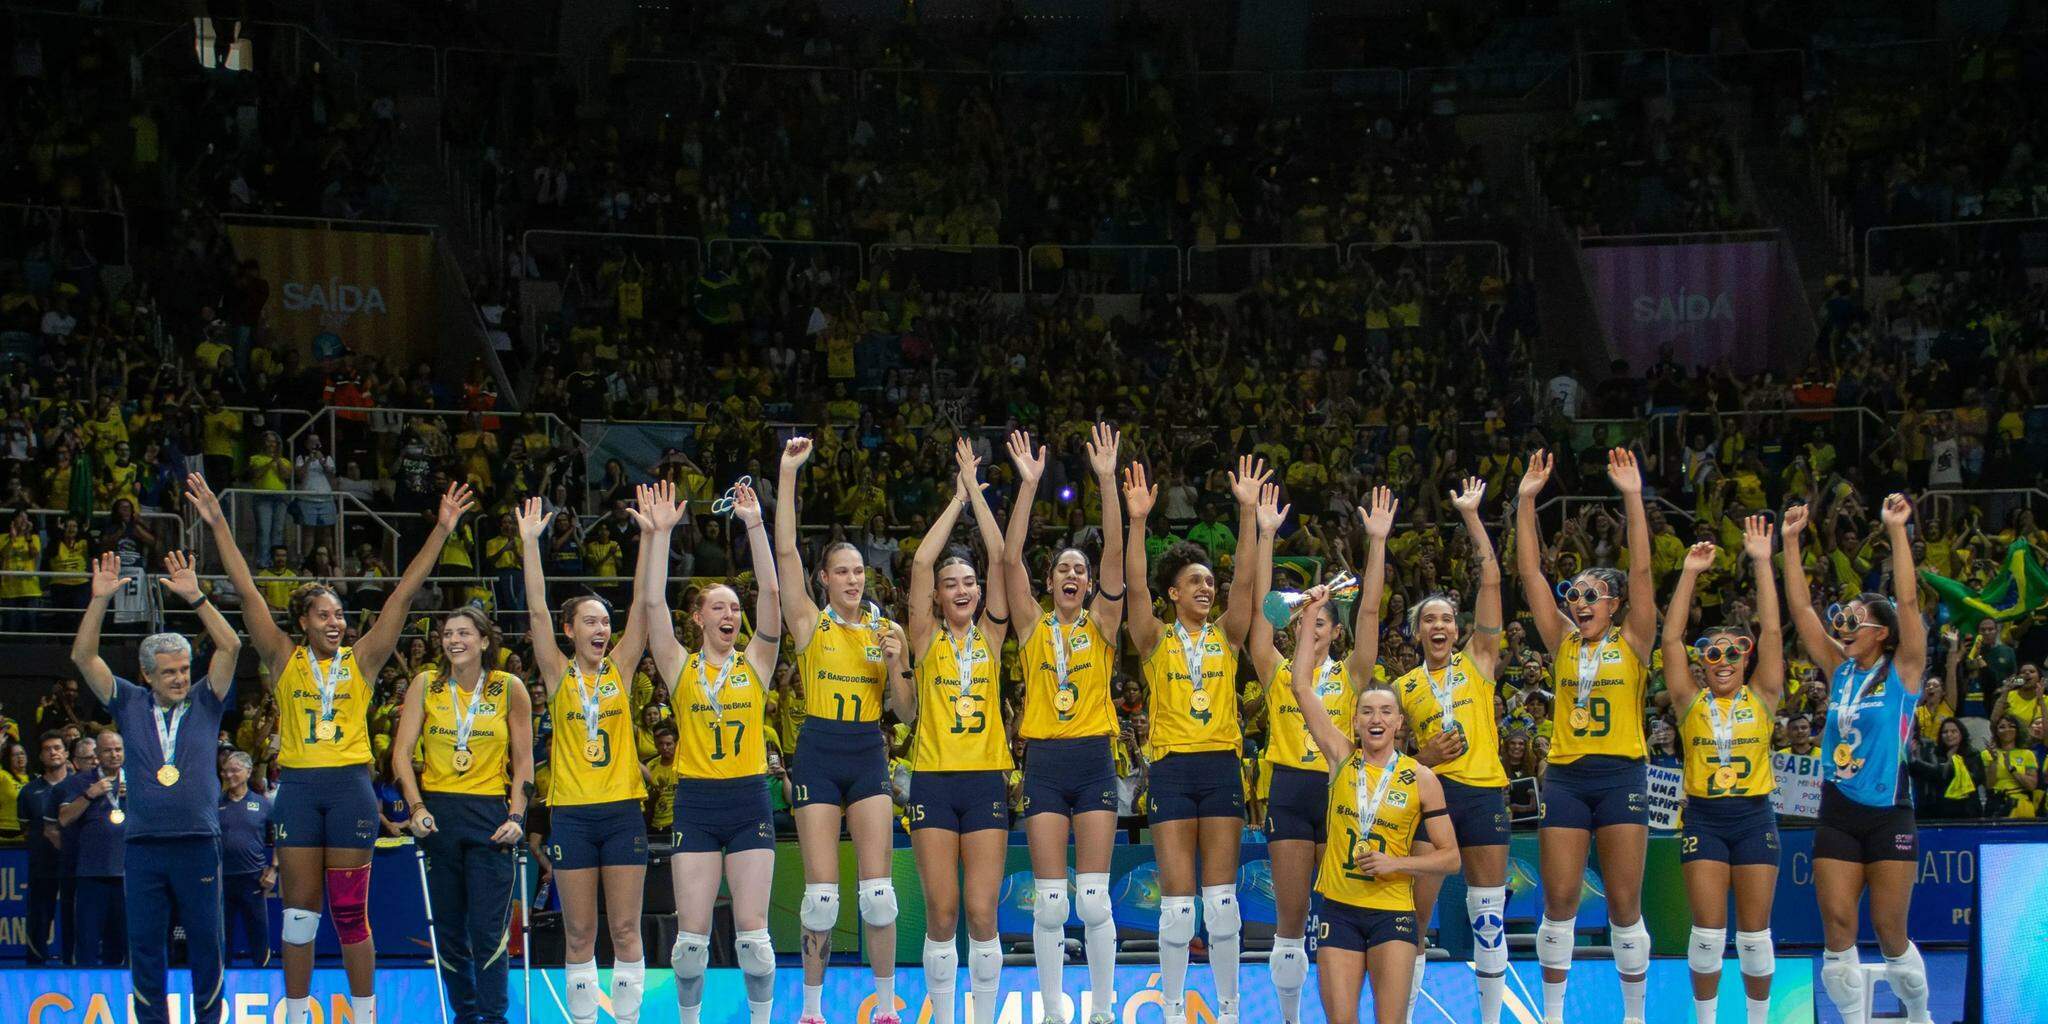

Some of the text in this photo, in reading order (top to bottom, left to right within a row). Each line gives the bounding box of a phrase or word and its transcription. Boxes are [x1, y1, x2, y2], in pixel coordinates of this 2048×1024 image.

[282, 275, 387, 316] SAÍDA
[1634, 284, 1735, 323] SAÍDA
[1600, 678, 1625, 687] BRASIL
[833, 692, 862, 722] 11
[472, 729, 495, 737] BRASIL
[709, 719, 746, 760] 17
[1772, 753, 1820, 777] GABI
[1706, 756, 1751, 795] 22
[796, 784, 809, 801] 11
[911, 804, 925, 822] 15
[554, 844, 562, 861] 9
[1682, 836, 1699, 854] 22
[1317, 921, 1330, 939] 0
